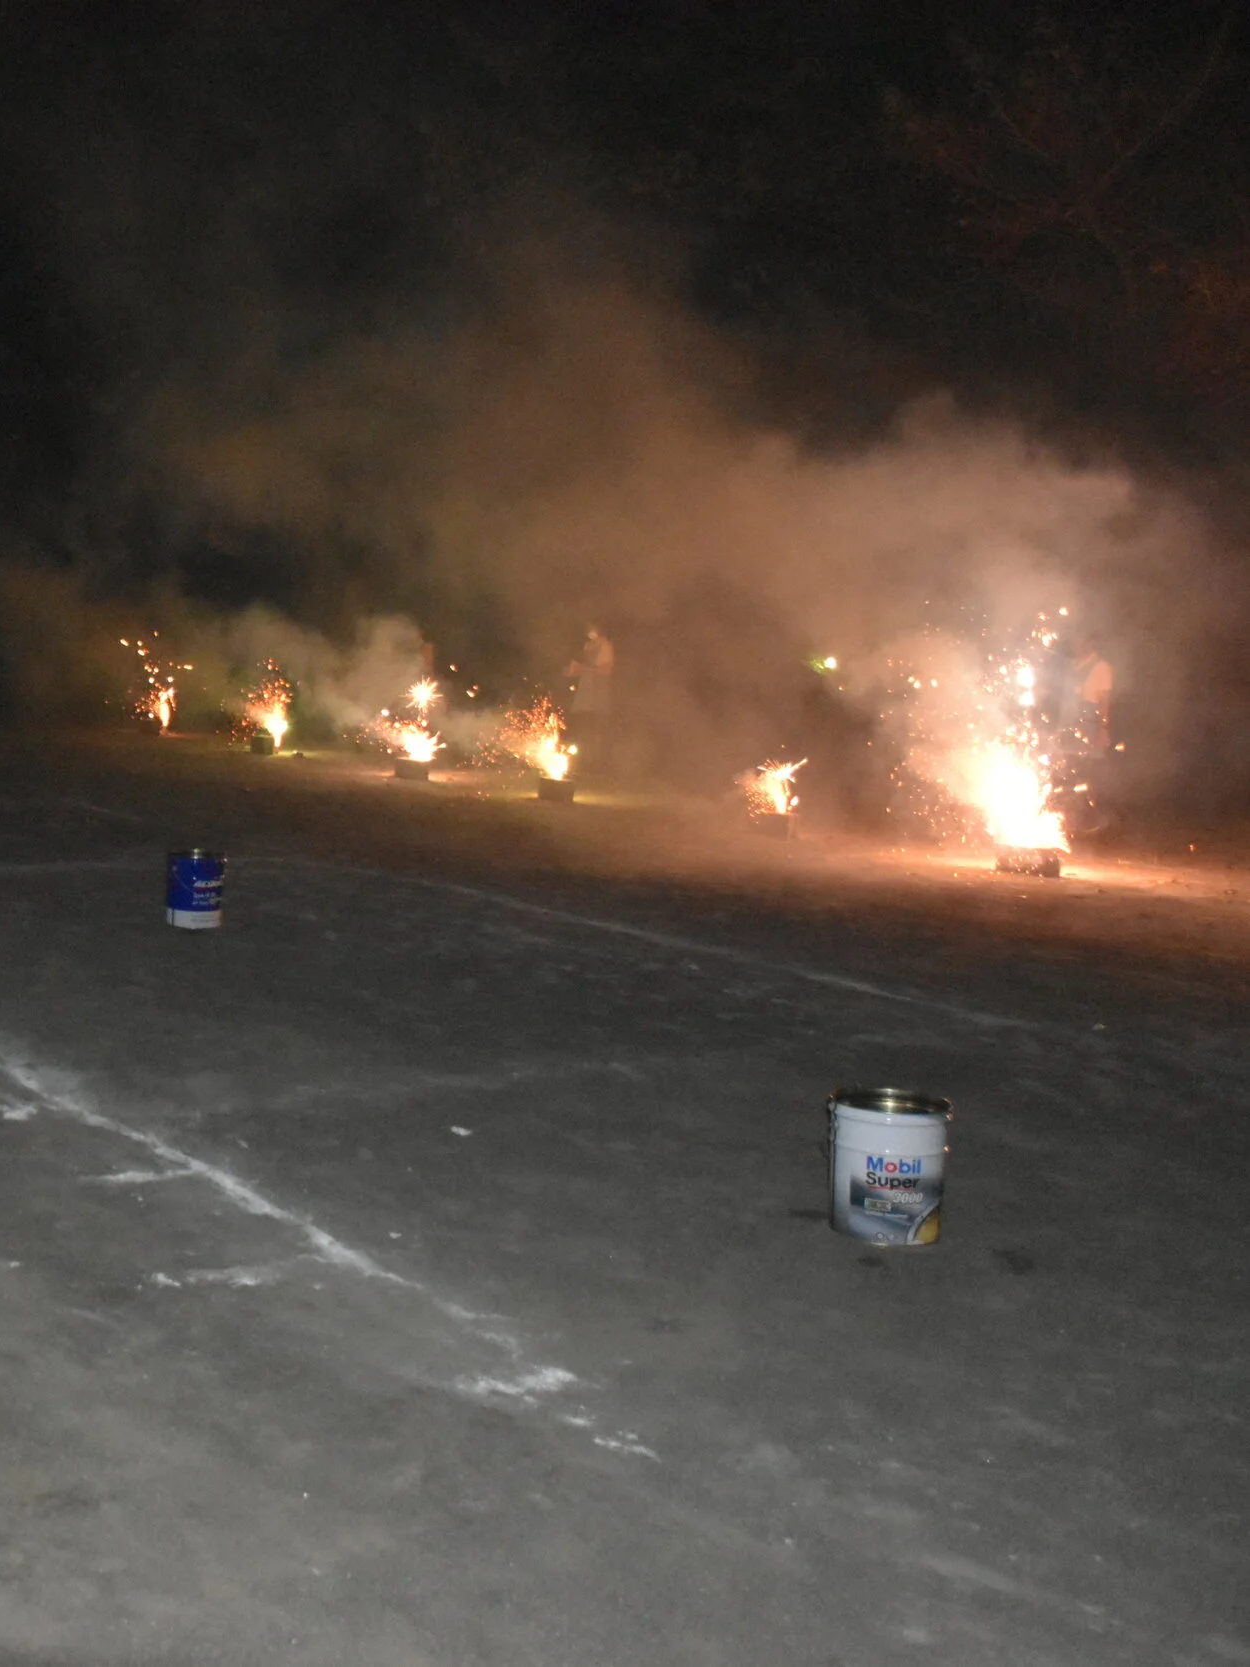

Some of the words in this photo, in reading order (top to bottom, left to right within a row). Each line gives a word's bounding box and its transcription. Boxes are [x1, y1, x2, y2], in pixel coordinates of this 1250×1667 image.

[866, 1156, 921, 1174] Mobil
[866, 1171, 920, 1190] Super
[892, 1192, 923, 1203] 3000
